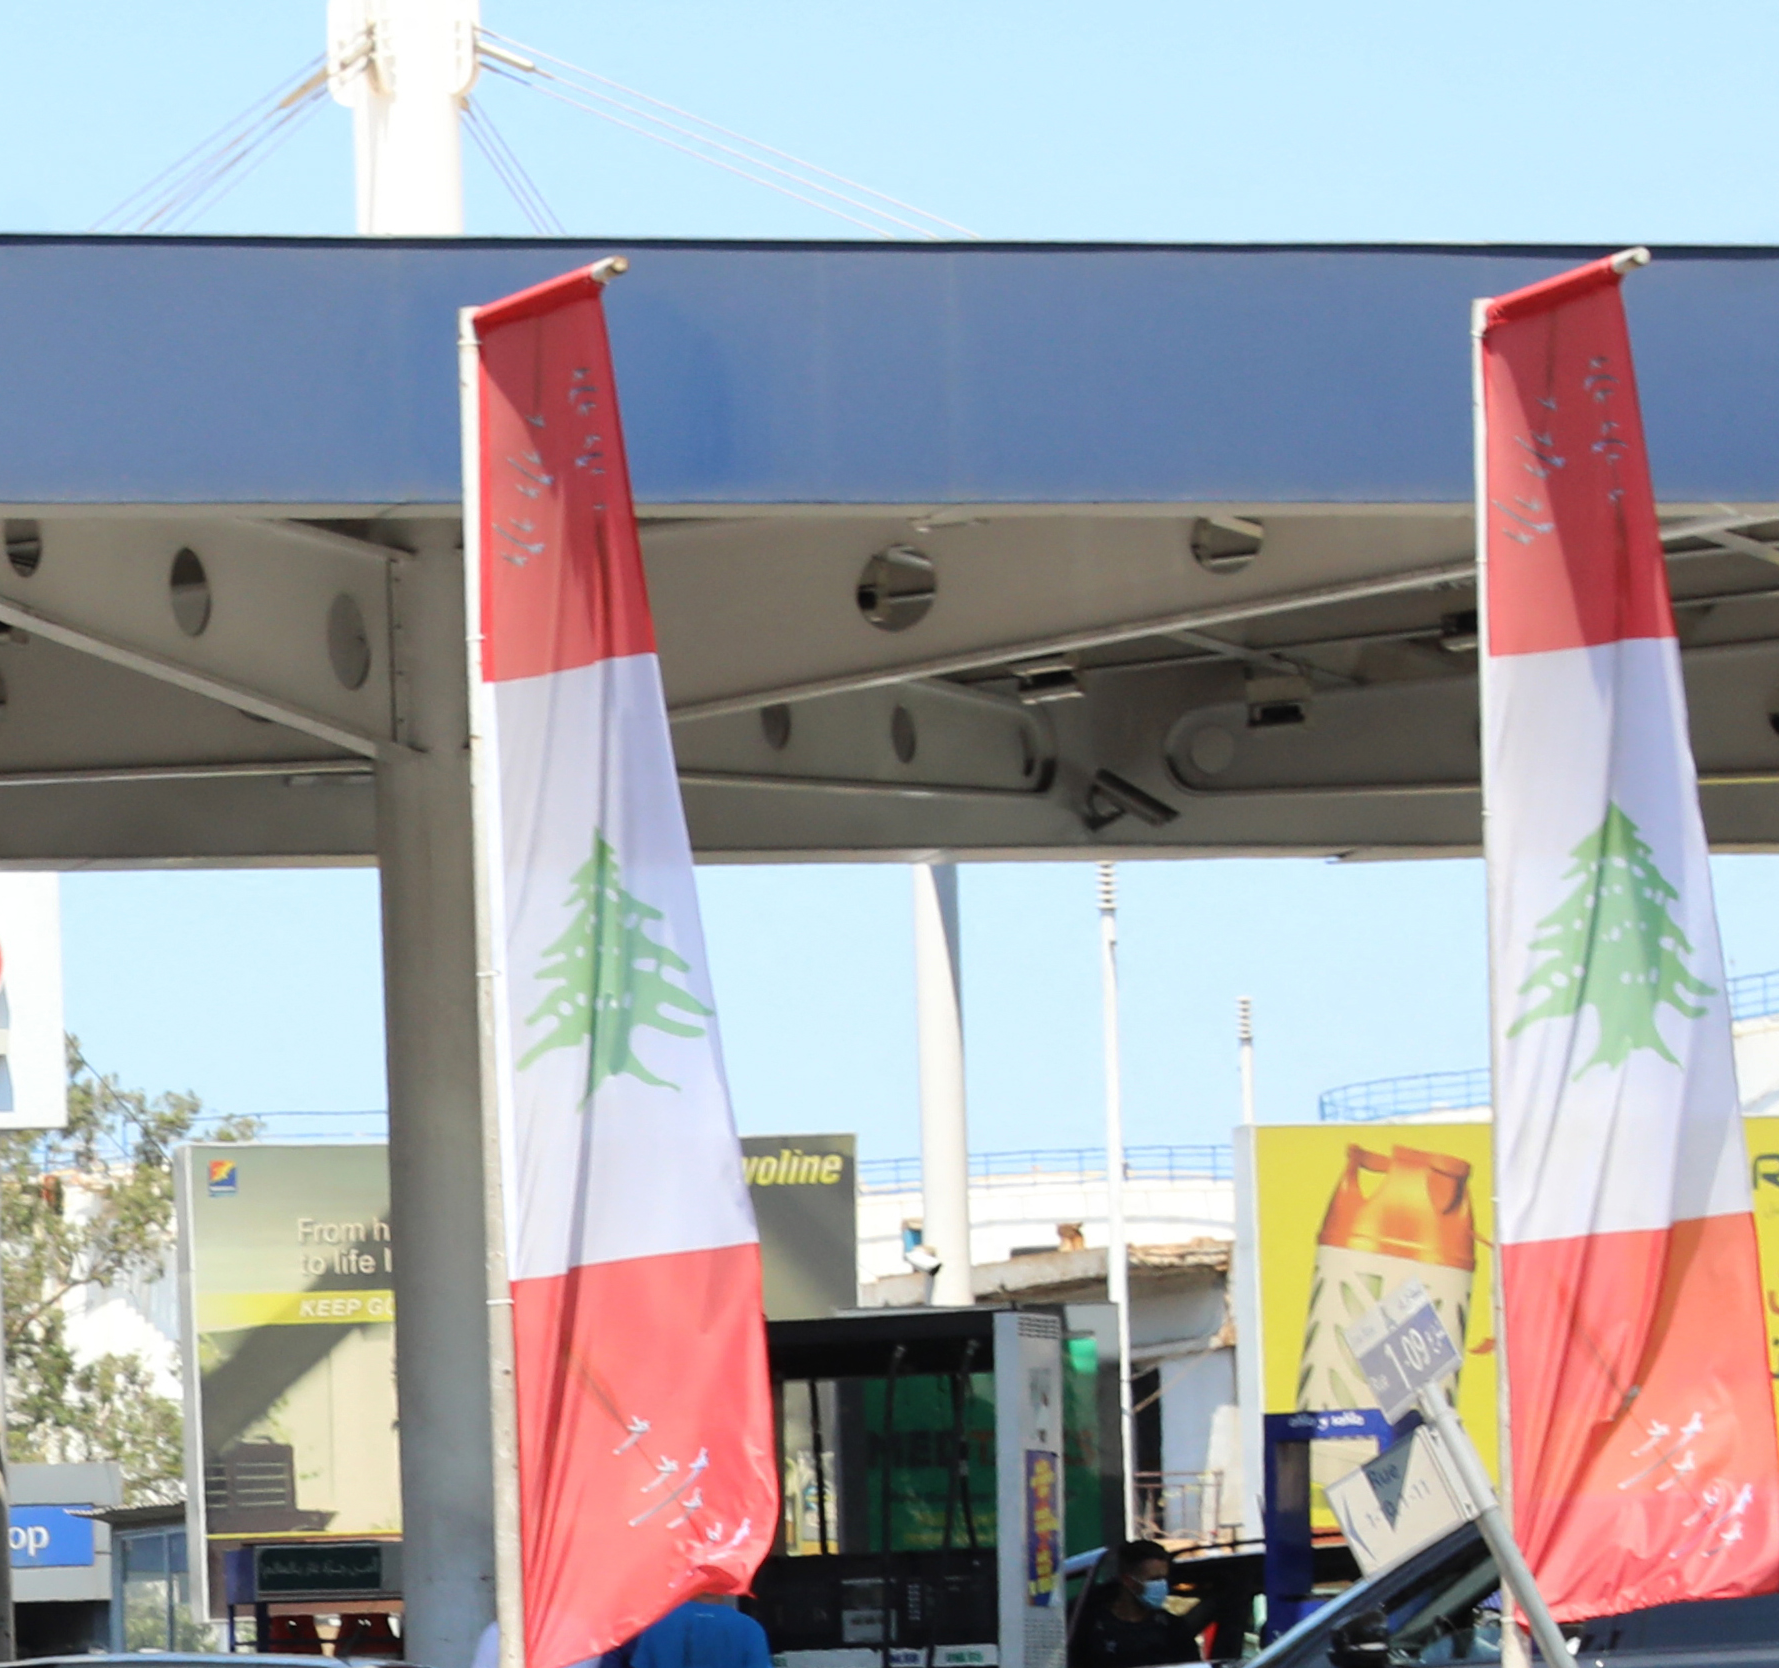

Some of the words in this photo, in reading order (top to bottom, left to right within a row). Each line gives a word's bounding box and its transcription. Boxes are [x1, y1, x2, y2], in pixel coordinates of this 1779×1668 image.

[297, 1218, 366, 1243] From
[372, 1216, 391, 1242] h
[301, 1253, 327, 1276] to
[333, 1247, 377, 1275] life
[299, 1297, 362, 1318] KEEP
